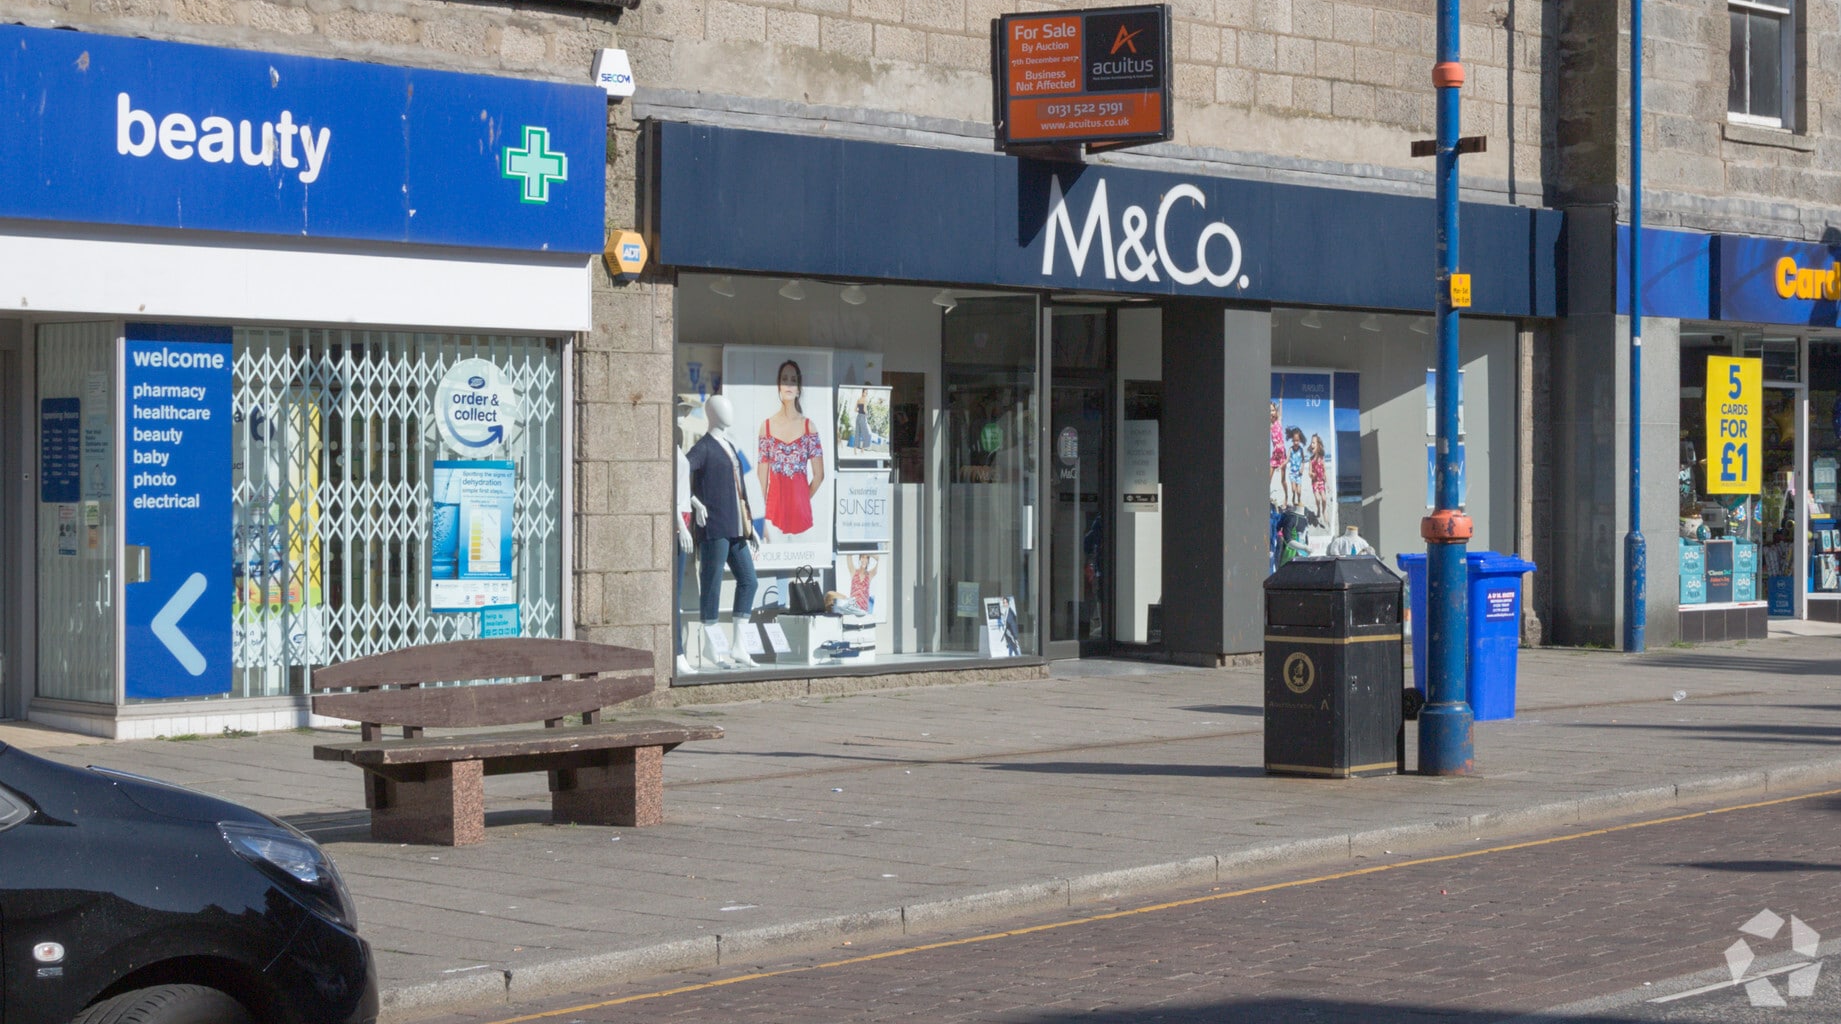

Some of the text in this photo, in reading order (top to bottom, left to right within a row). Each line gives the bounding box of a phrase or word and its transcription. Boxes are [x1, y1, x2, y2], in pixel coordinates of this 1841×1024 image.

[1015, 22, 1076, 40] For Sale
[1021, 41, 1069, 53] By Auction
[1025, 56, 1060, 65] December
[1092, 57, 1154, 75] acuitus
[601, 73, 631, 84] SECOM
[1025, 70, 1067, 80] Business
[1016, 79, 1076, 91] Not Affected
[1047, 102, 1123, 118] 0131 522 5191
[1041, 117, 1130, 131] www.acuitus.co.uk
[117, 92, 331, 184] beauty
[1042, 174, 1250, 289] M&Co.
[622, 246, 640, 260] ADT
[132, 347, 225, 369] welcome
[1728, 364, 1742, 400] 5
[132, 382, 207, 401] pharmacy
[452, 392, 499, 406] order &
[132, 404, 212, 421] healthcare
[454, 407, 497, 422] collect
[1721, 403, 1749, 416] CARDS
[132, 426, 183, 445] beauty
[1720, 419, 1748, 438] FOR
[132, 449, 170, 467] baby
[1720, 441, 1748, 482] £1
[132, 471, 177, 489] photo
[462, 479, 502, 487] dehydration
[132, 493, 200, 509] electrical
[839, 498, 886, 516] SUNSET
